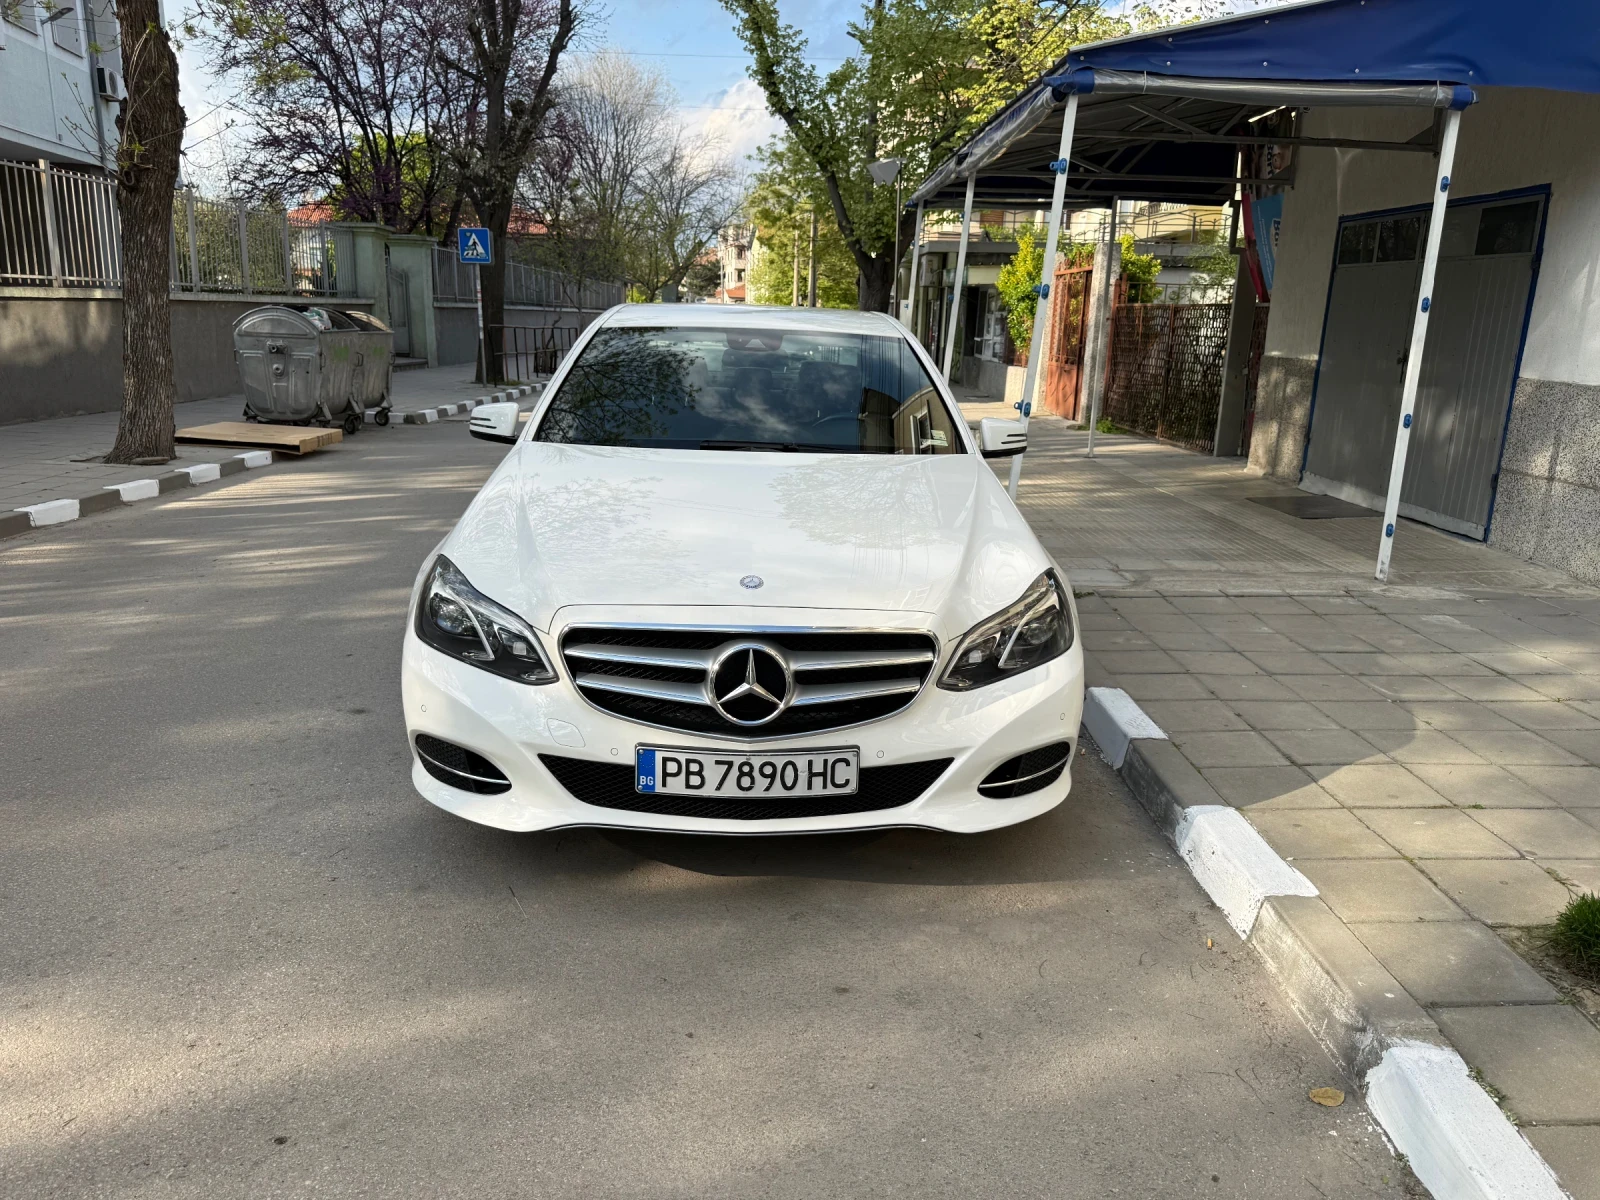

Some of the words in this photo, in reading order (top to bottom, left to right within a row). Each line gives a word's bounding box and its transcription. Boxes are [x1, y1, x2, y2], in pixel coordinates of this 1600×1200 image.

[639, 775, 654, 786] BG
[661, 756, 706, 790] PB
[714, 760, 799, 792] 7890
[807, 757, 851, 790] HC
